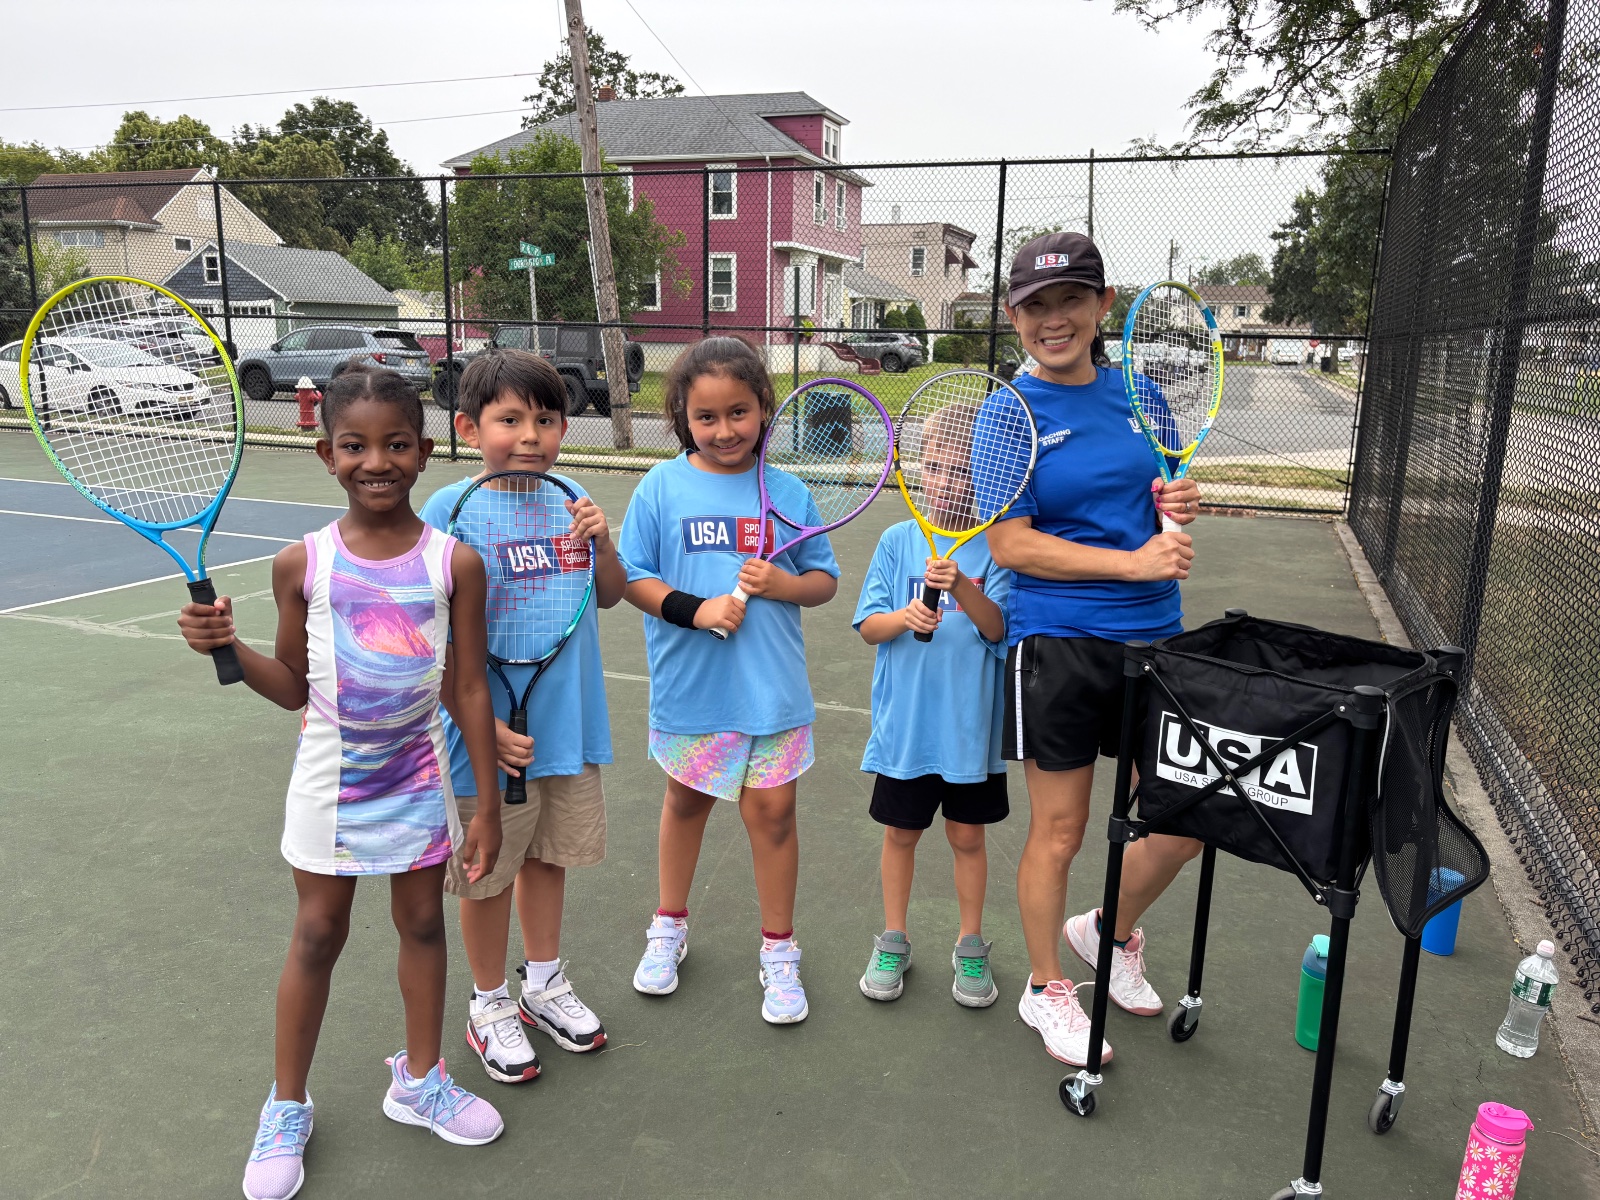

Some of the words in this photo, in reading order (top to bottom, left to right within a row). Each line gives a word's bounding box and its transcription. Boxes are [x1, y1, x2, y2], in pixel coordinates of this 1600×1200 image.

[1037, 255, 1067, 266] USA
[1038, 428, 1072, 442] OACHING
[1042, 436, 1065, 447] STAFF
[690, 521, 730, 546] USA
[744, 523, 760, 534] SPO
[507, 544, 552, 573] USA
[565, 551, 588, 565] GROUP
[913, 582, 950, 605] UA
[1165, 721, 1307, 795] USA
[1174, 770, 1198, 785] USA
[1247, 787, 1289, 807] GROUP
